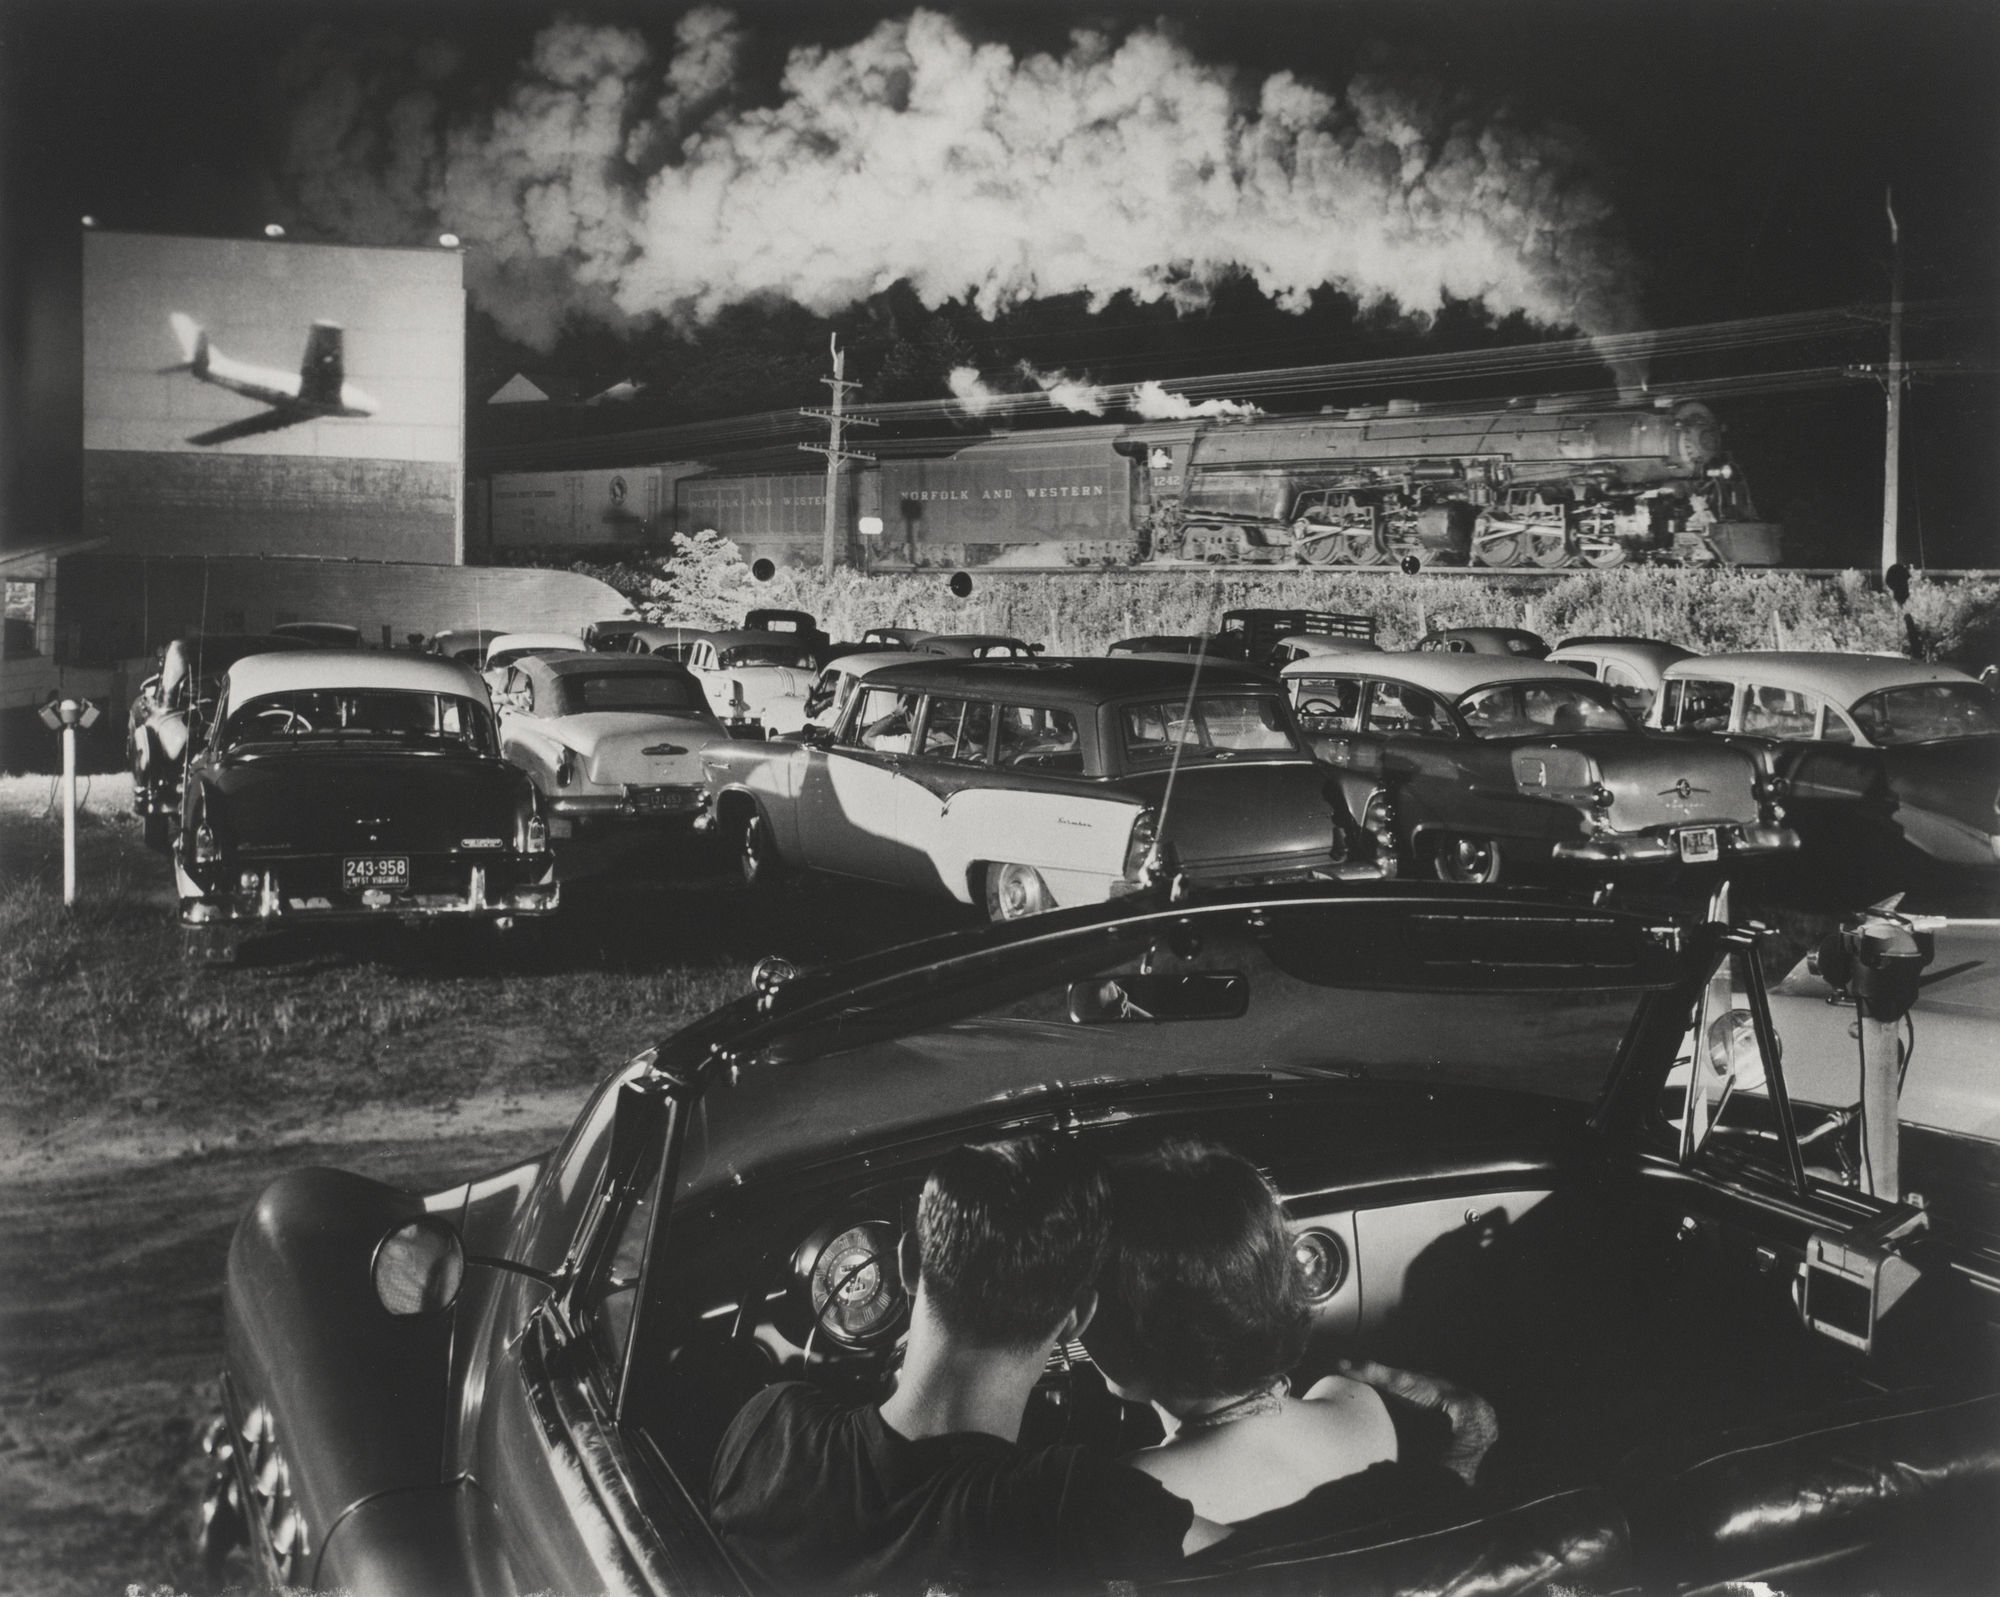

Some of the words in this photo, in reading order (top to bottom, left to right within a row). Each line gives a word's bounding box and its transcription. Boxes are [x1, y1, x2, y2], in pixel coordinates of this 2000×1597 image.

[1154, 476, 1181, 487] 1242
[902, 489, 969, 501] NORFOLK
[982, 488, 1013, 500] AND
[1026, 485, 1103, 499] WESTERN
